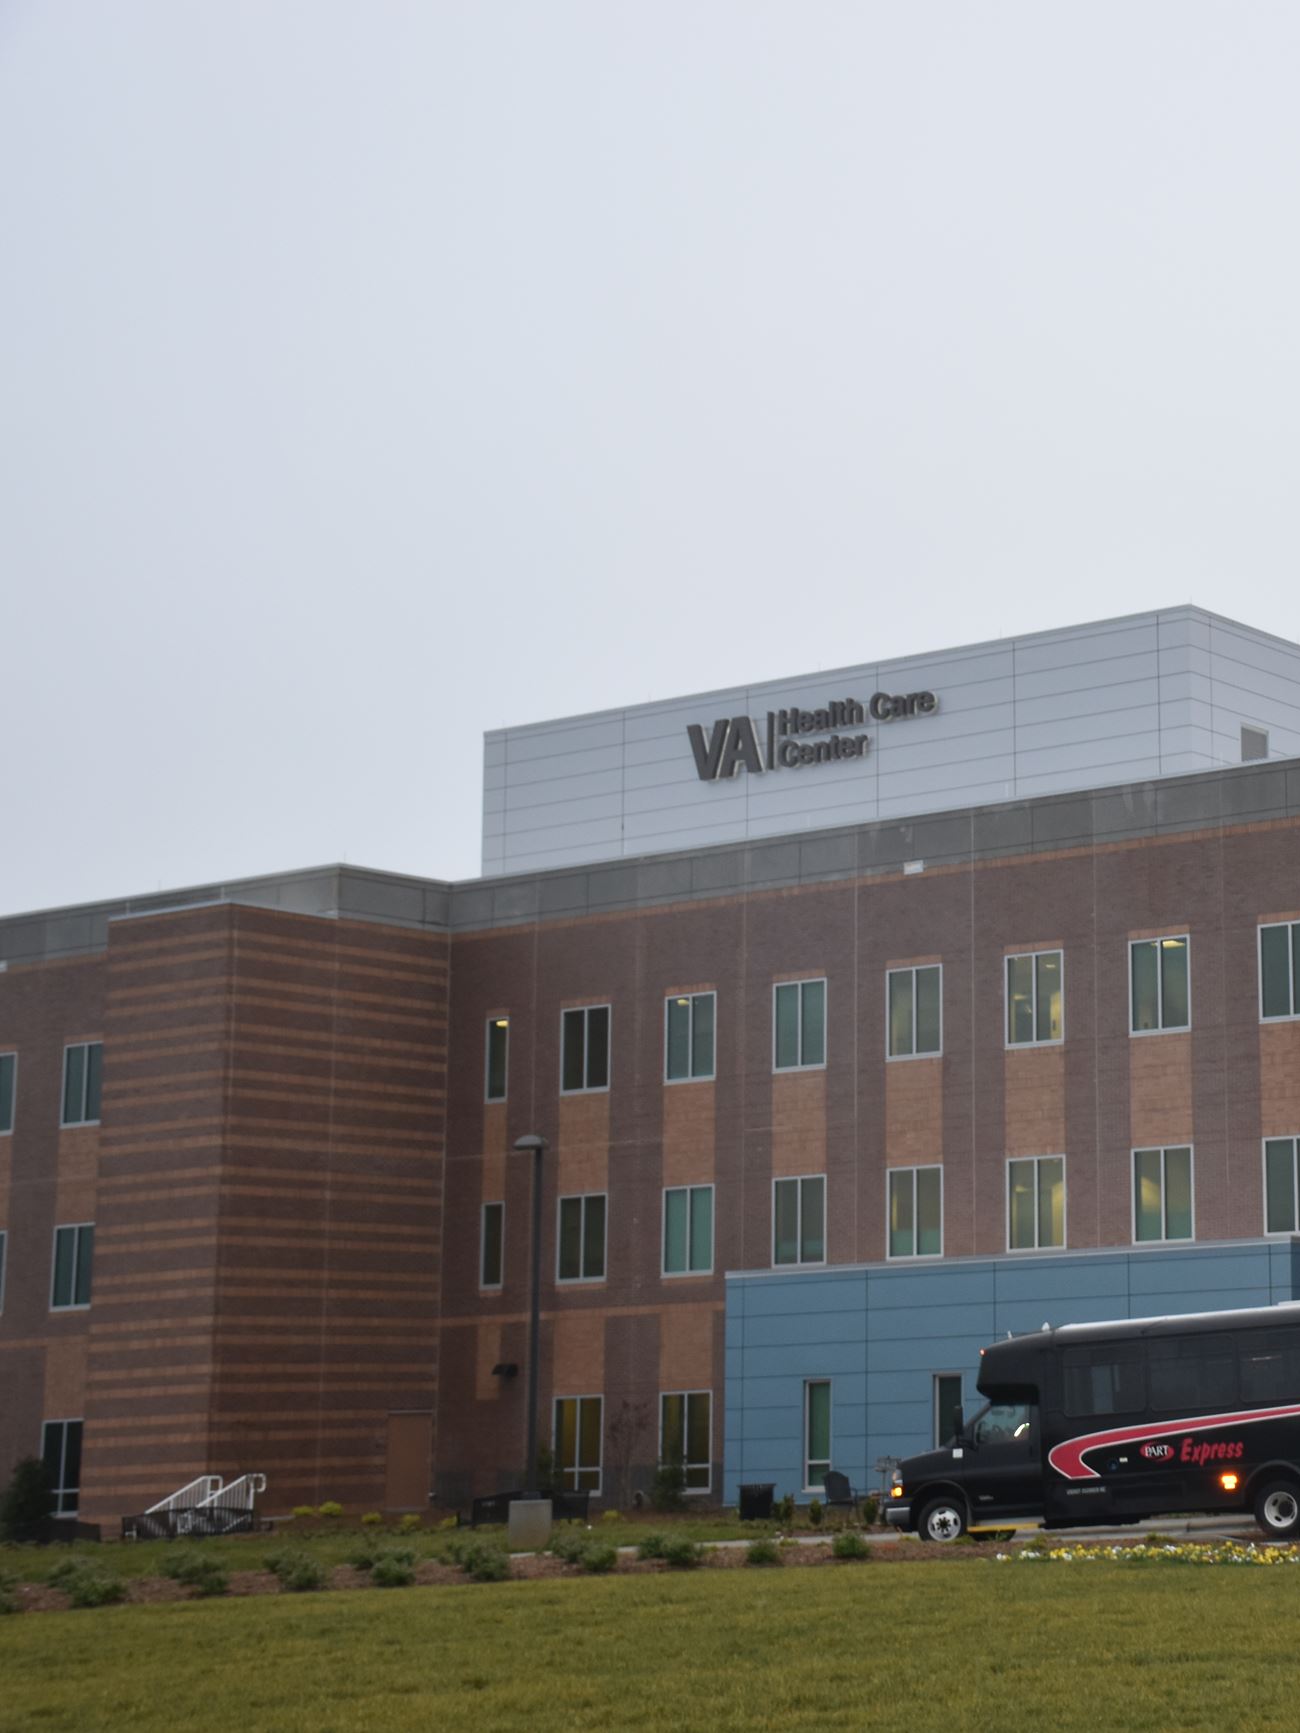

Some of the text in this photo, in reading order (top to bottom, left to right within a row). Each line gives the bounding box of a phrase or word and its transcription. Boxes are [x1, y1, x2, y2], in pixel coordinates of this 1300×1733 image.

[687, 691, 936, 780] VA Health Care
[777, 734, 868, 767] Center
[1144, 1437, 1244, 1466] PART Express
